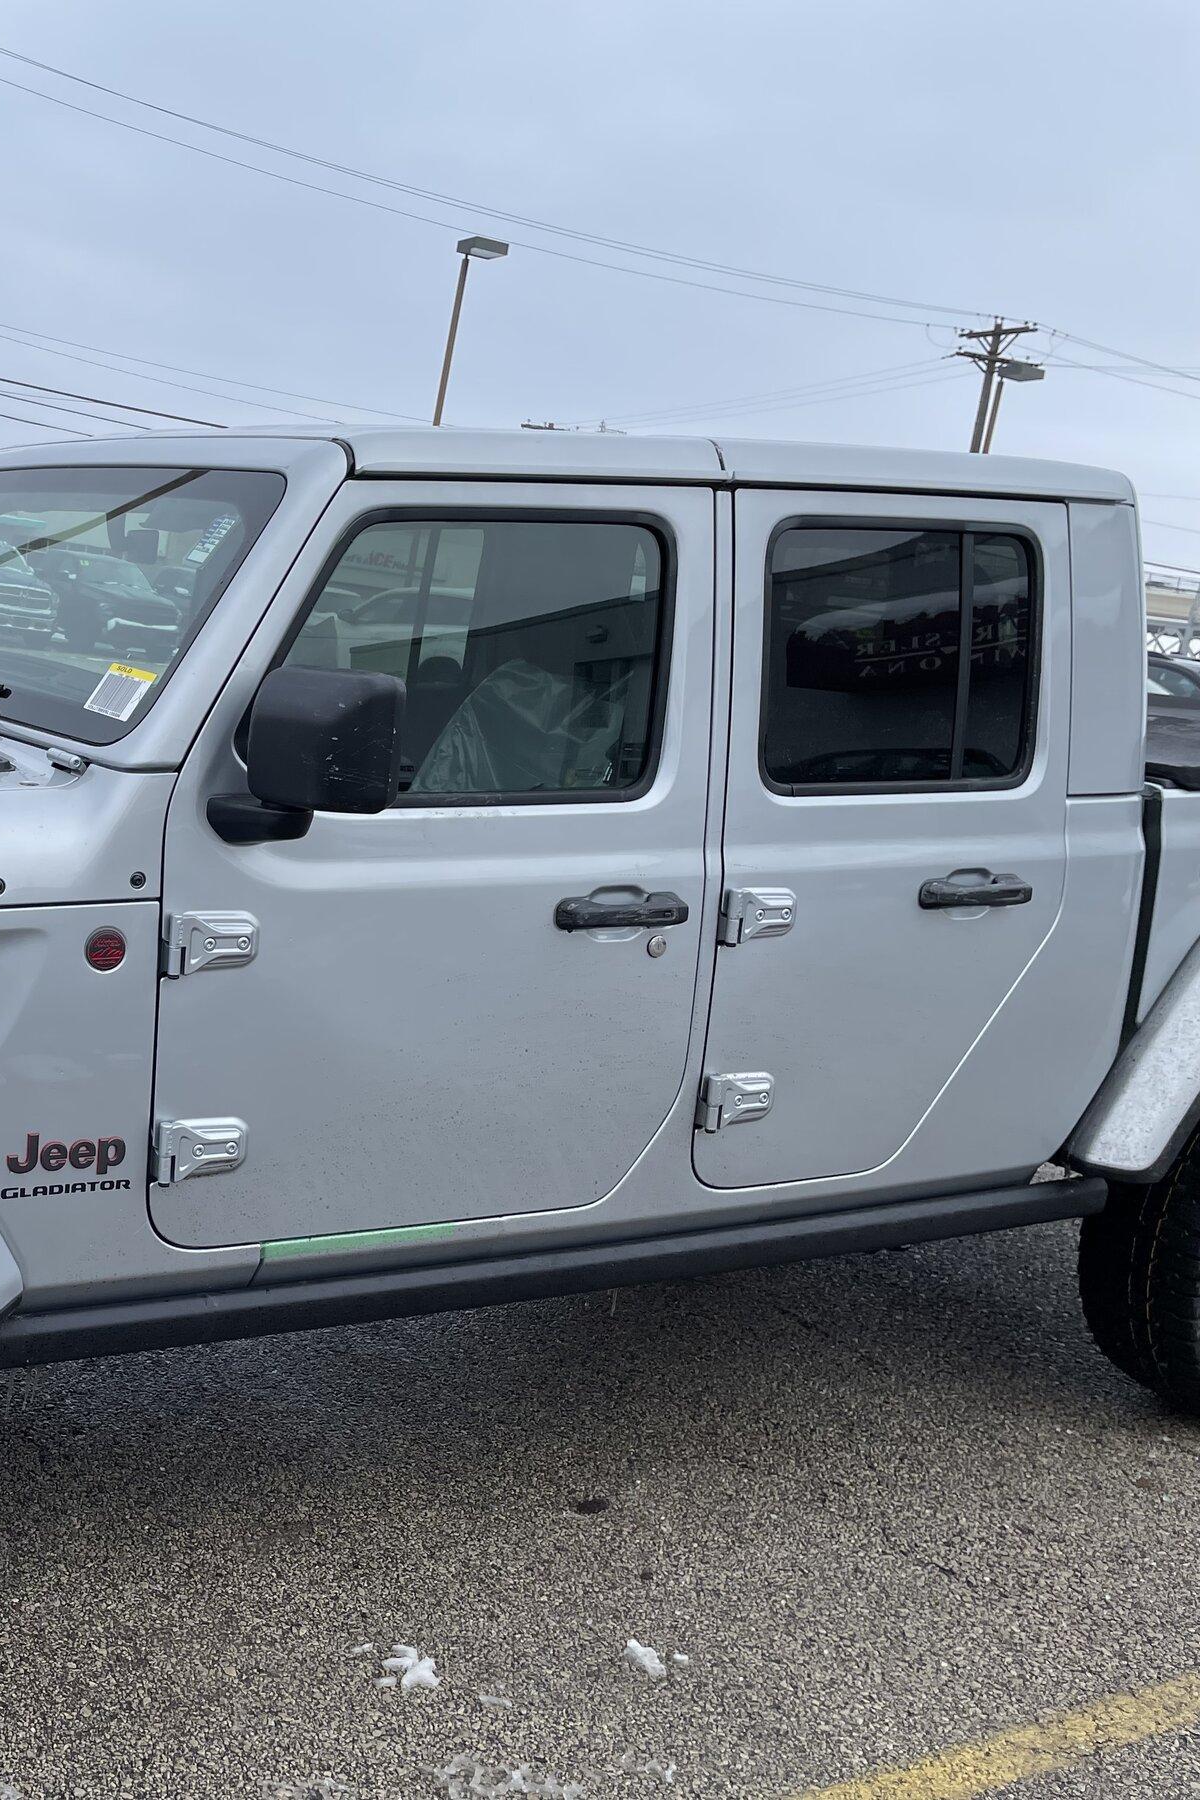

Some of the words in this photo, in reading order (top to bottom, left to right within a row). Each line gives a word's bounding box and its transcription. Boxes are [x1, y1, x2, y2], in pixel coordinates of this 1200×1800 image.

[116, 664, 134, 674] SOLD
[6, 1132, 127, 1175] Jeep
[0, 1179, 131, 1200] GLADIATOR
